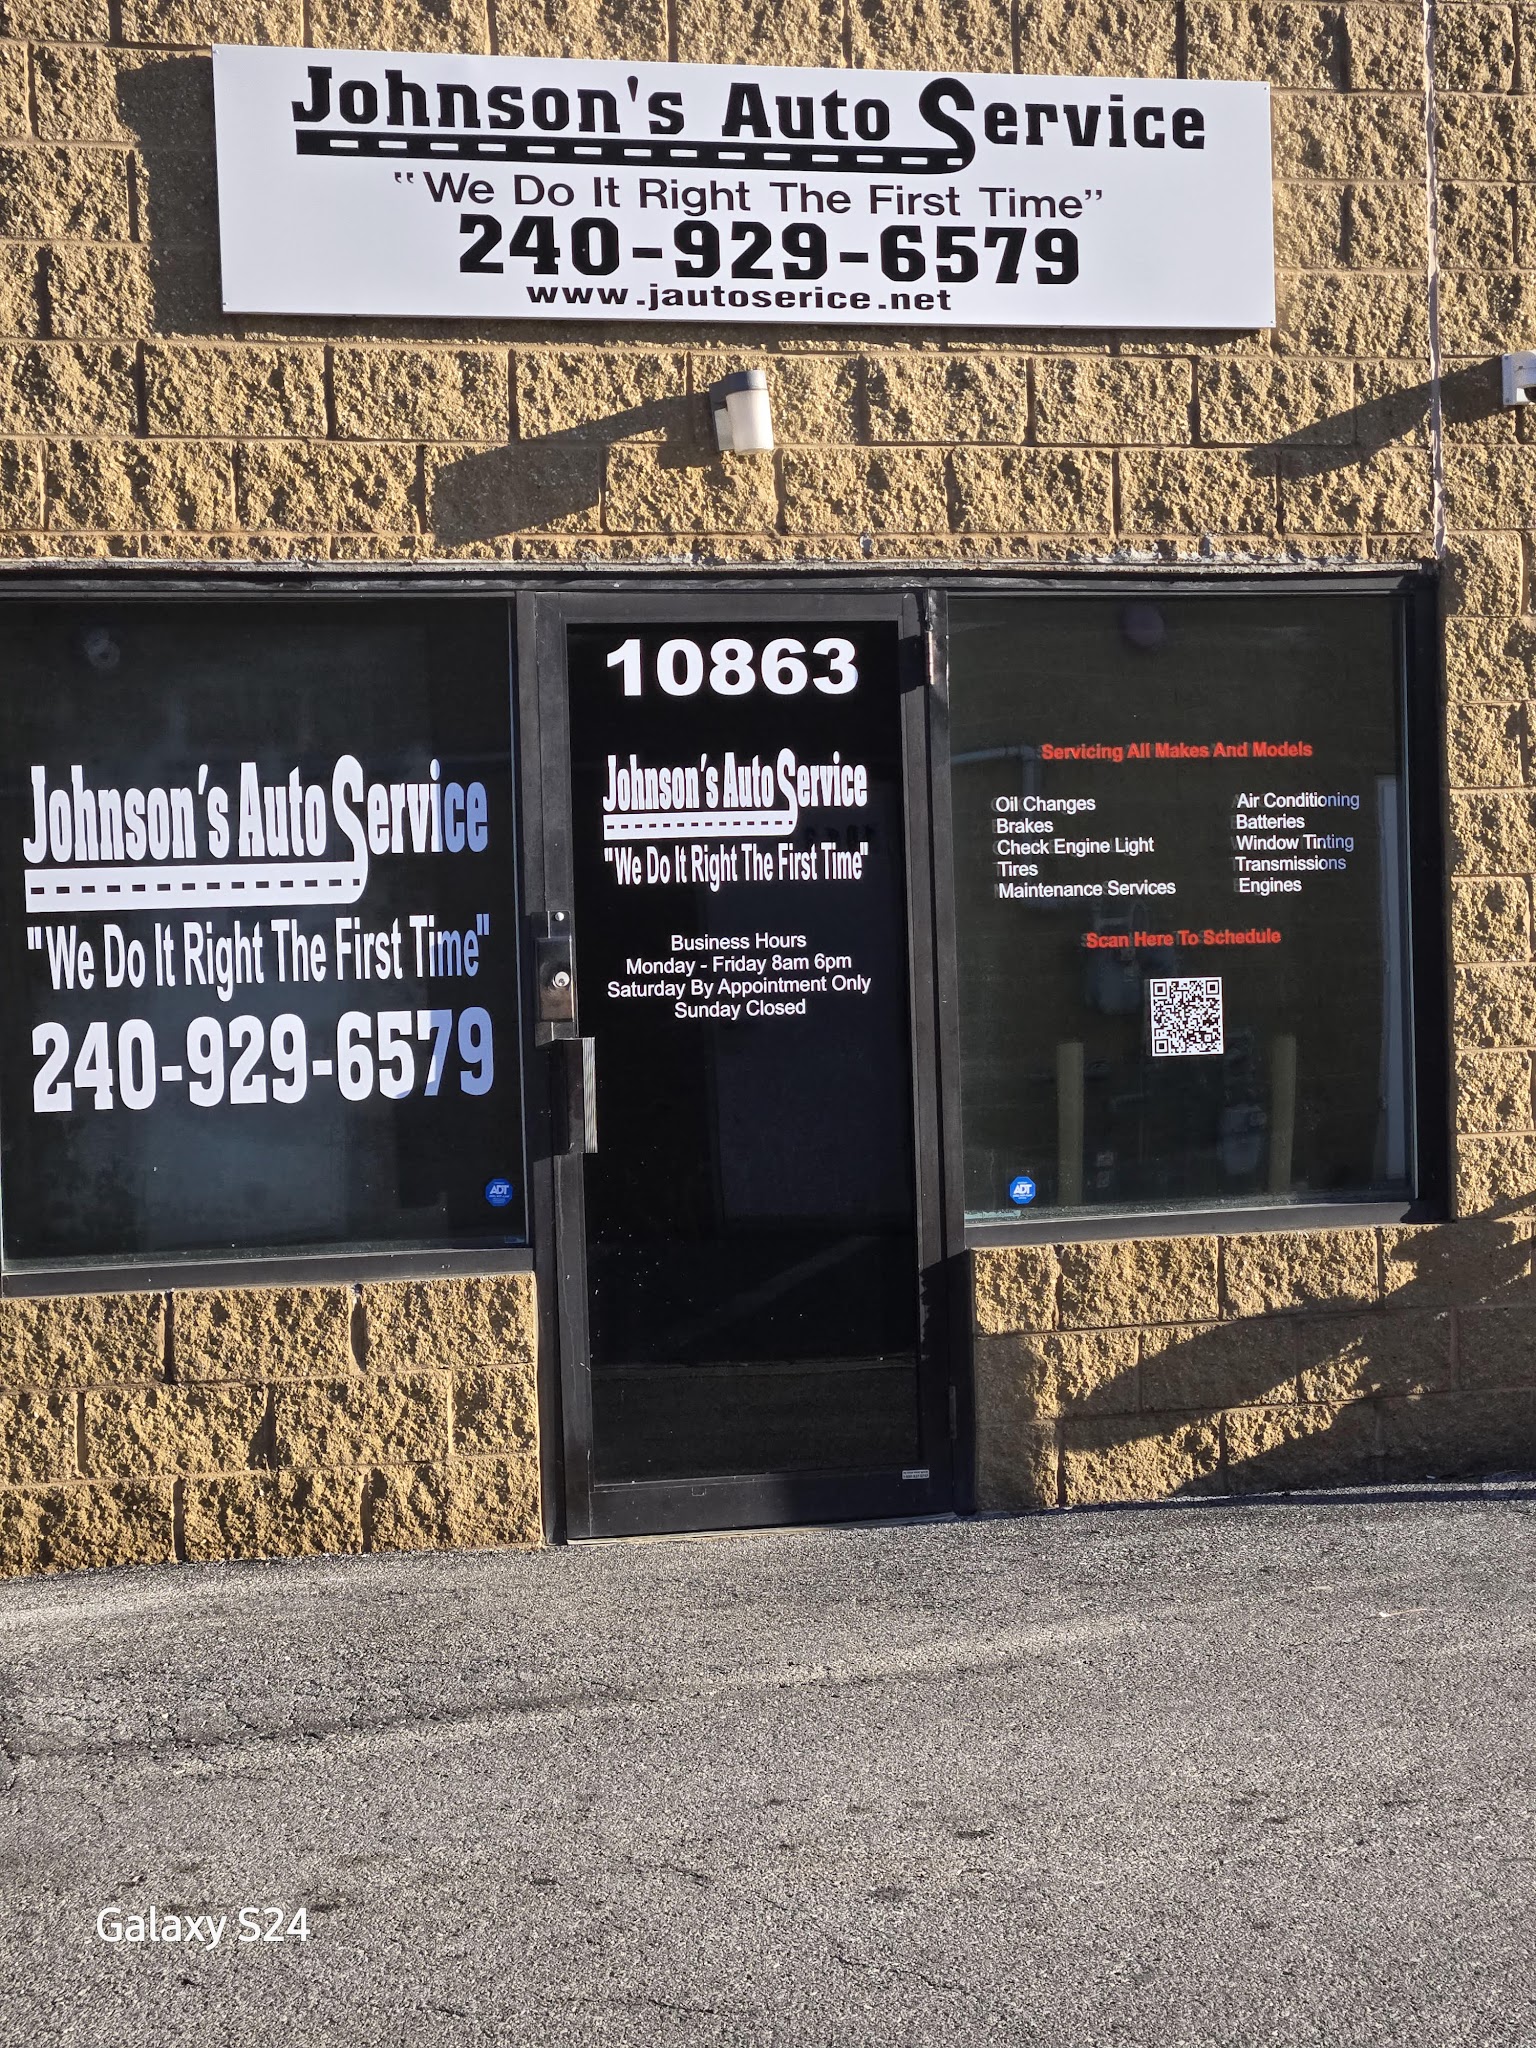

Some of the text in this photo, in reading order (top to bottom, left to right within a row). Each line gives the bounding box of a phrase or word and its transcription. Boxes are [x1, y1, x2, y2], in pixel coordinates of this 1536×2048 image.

[291, 66, 1205, 157] Johnson's Auto Service
[514, 175, 574, 207] Do
[594, 177, 620, 208] It
[639, 179, 750, 216] Right
[770, 182, 851, 214] The
[870, 184, 960, 217] First
[459, 213, 1079, 285] 240-929-6579
[526, 283, 951, 311] www.jautoserice.net
[607, 638, 858, 696] 10863
[1041, 741, 1313, 762] Servicing All Makes And Models
[603, 748, 867, 814] Johnson's Auto Service
[23, 754, 488, 864] Johnson's Auto Service
[995, 796, 1096, 814] Oil Changes
[1237, 792, 1360, 809] Air Conditioning
[996, 818, 1054, 834] Brakes
[1236, 814, 1305, 830] Batteries
[997, 837, 1154, 857] Check Engine Light
[1236, 834, 1354, 853] Window Tinting
[605, 842, 868, 892] "We Do It Right The First Time"
[998, 861, 1038, 876] Tires
[1235, 855, 1346, 872] Transmissions
[998, 880, 1176, 898] Maintenance Services
[1238, 877, 1302, 895] Engines
[671, 933, 806, 951] Business Hours
[1086, 928, 1281, 948] Scan Here To Schedule
[27, 913, 489, 1002] "We Do It Right The First Time"
[626, 958, 695, 977] Monday
[713, 957, 766, 975] Friday
[771, 955, 809, 971] 8am
[814, 954, 852, 972] 6pm
[607, 976, 871, 999] Saturday By Appointment Only
[674, 1000, 806, 1021] Sunday Closed
[32, 1006, 494, 1113] 240-929-6579
[490, 1185, 509, 1194] ADT
[1014, 1184, 1032, 1194] ADT
